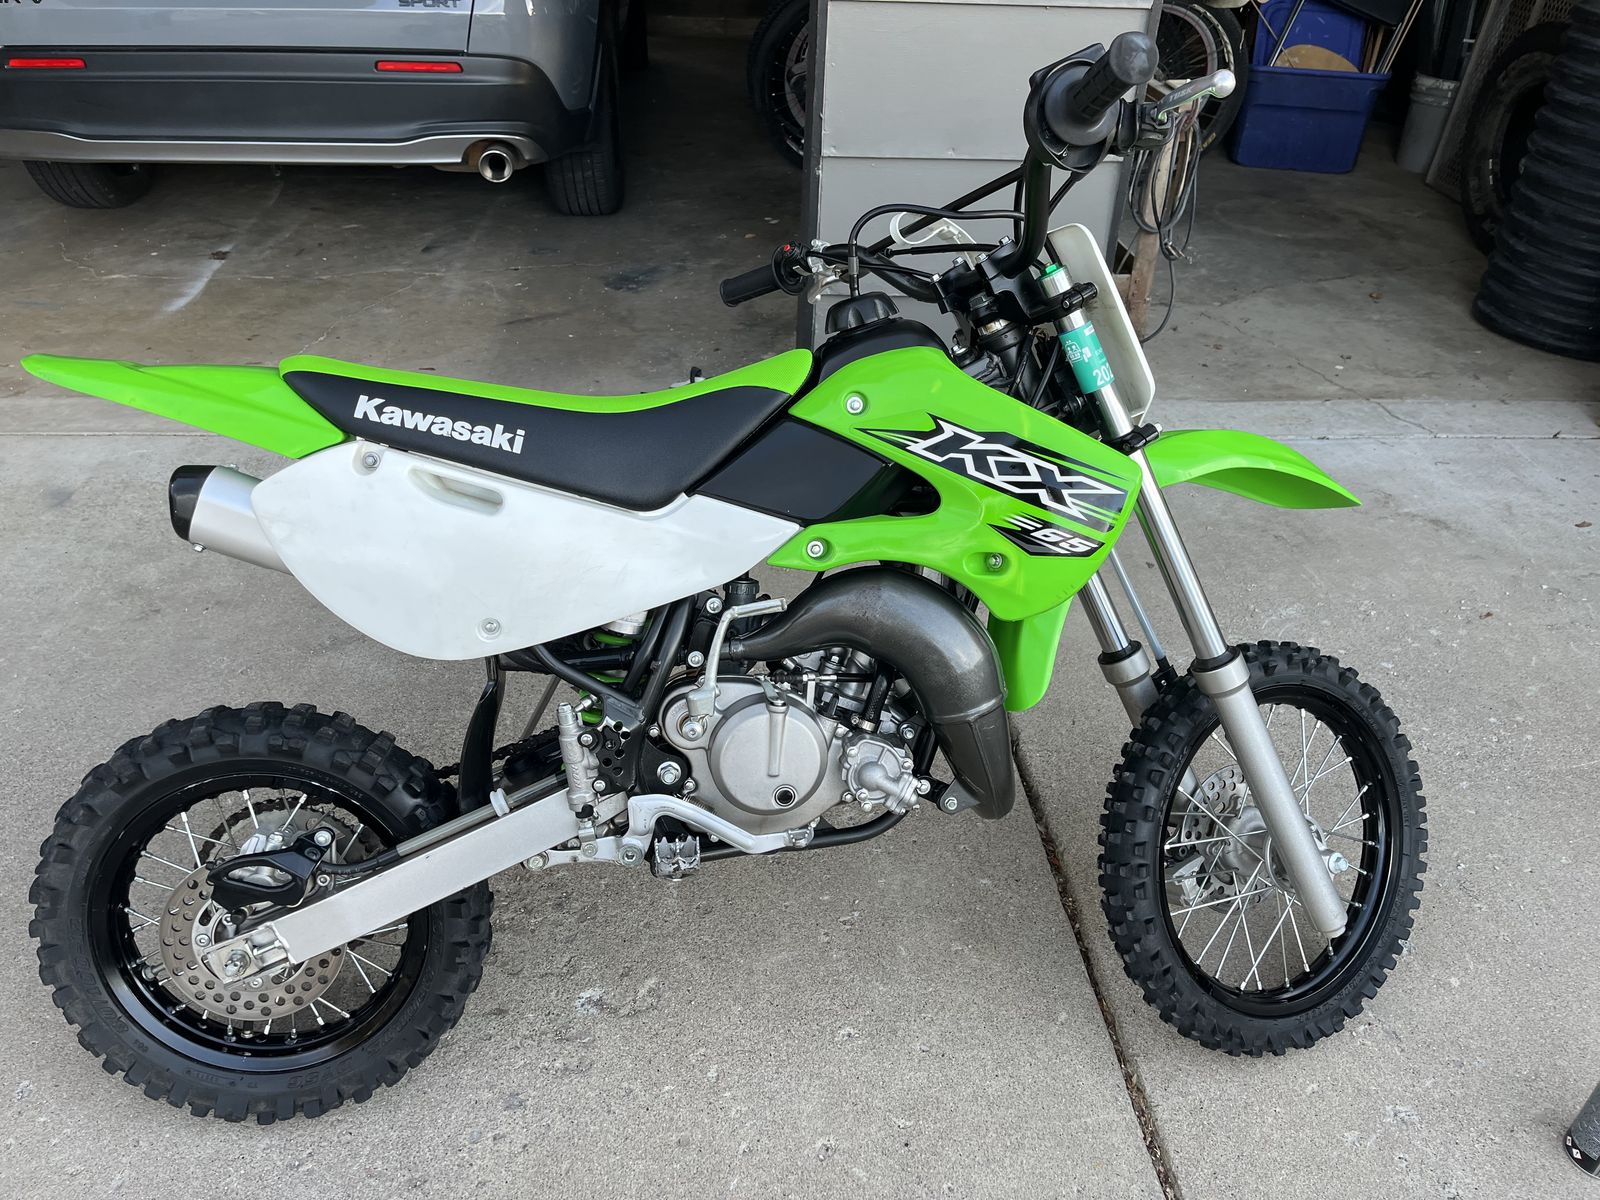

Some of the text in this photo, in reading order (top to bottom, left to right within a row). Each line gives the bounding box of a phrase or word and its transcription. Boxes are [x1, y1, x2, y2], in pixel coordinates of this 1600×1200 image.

[353, 394, 526, 455] Kawasaki
[905, 418, 1126, 522] KX
[1029, 528, 1099, 553] 65
